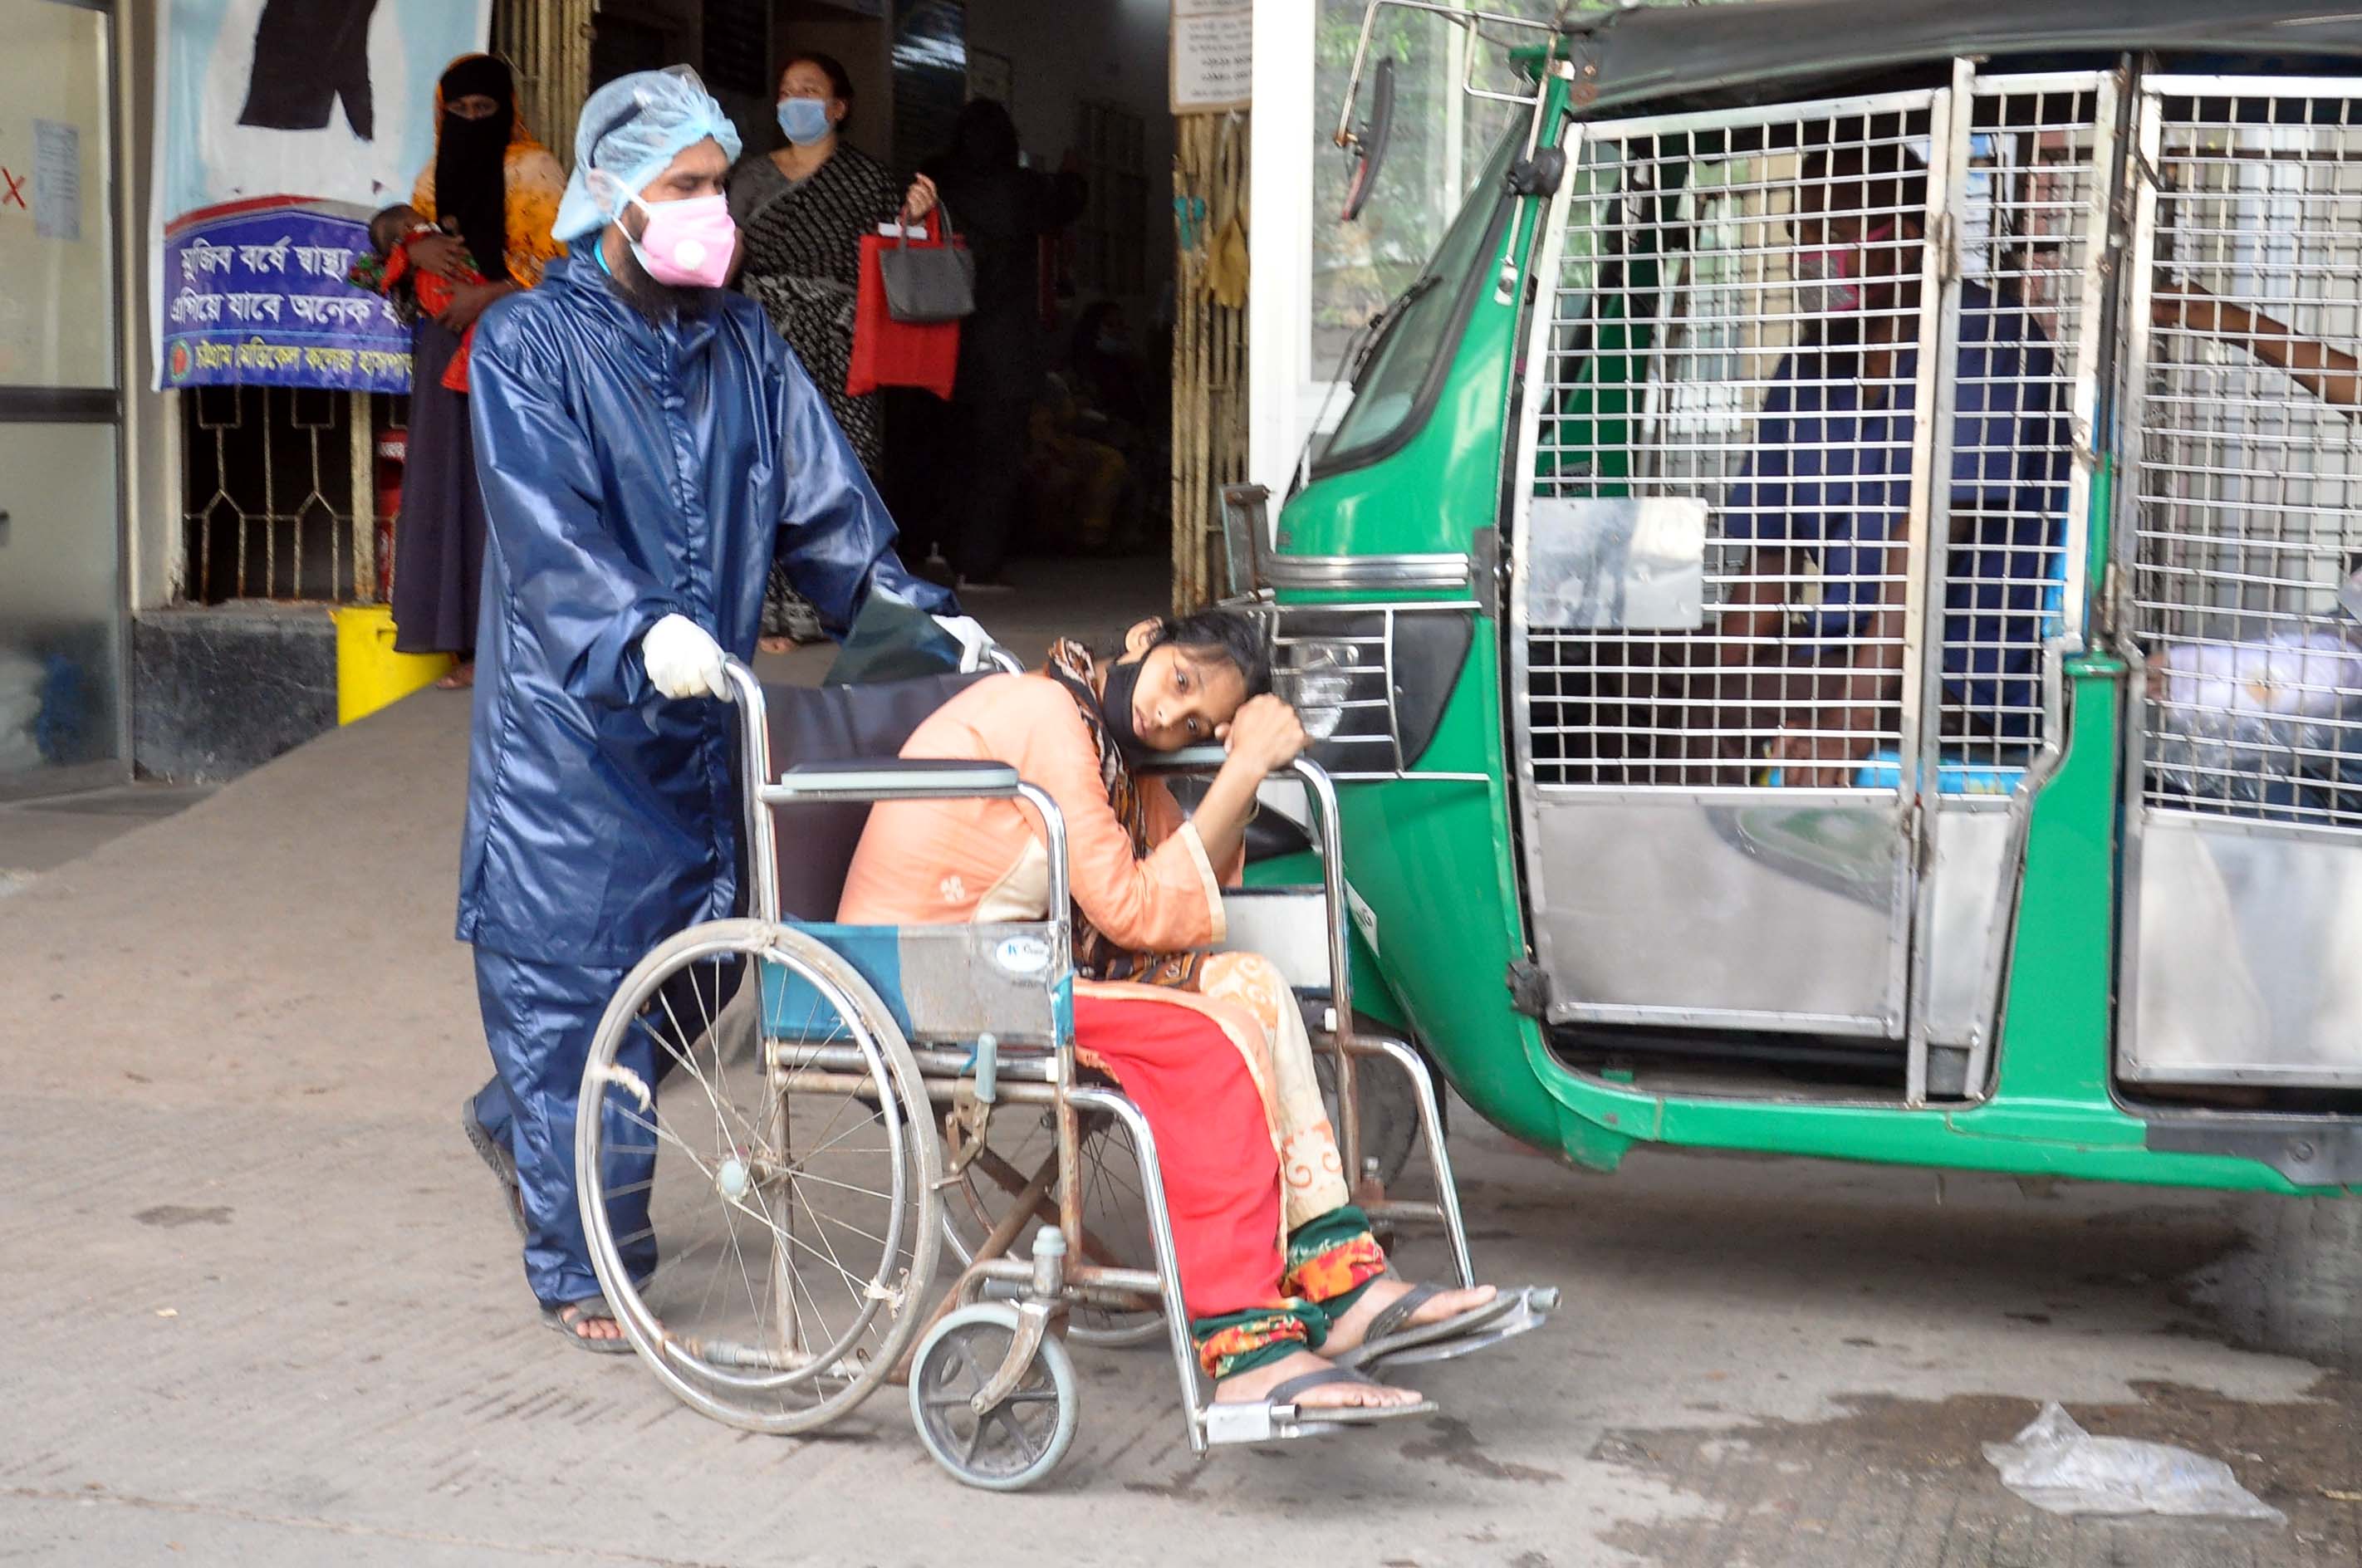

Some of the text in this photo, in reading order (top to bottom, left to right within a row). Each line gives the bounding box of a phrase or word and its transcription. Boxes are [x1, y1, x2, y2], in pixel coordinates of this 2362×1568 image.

[179, 238, 236, 283] মুজিব
[238, 235, 292, 274] বর্ষে
[226, 292, 285, 323] যাবে
[288, 294, 374, 328] অনেক
